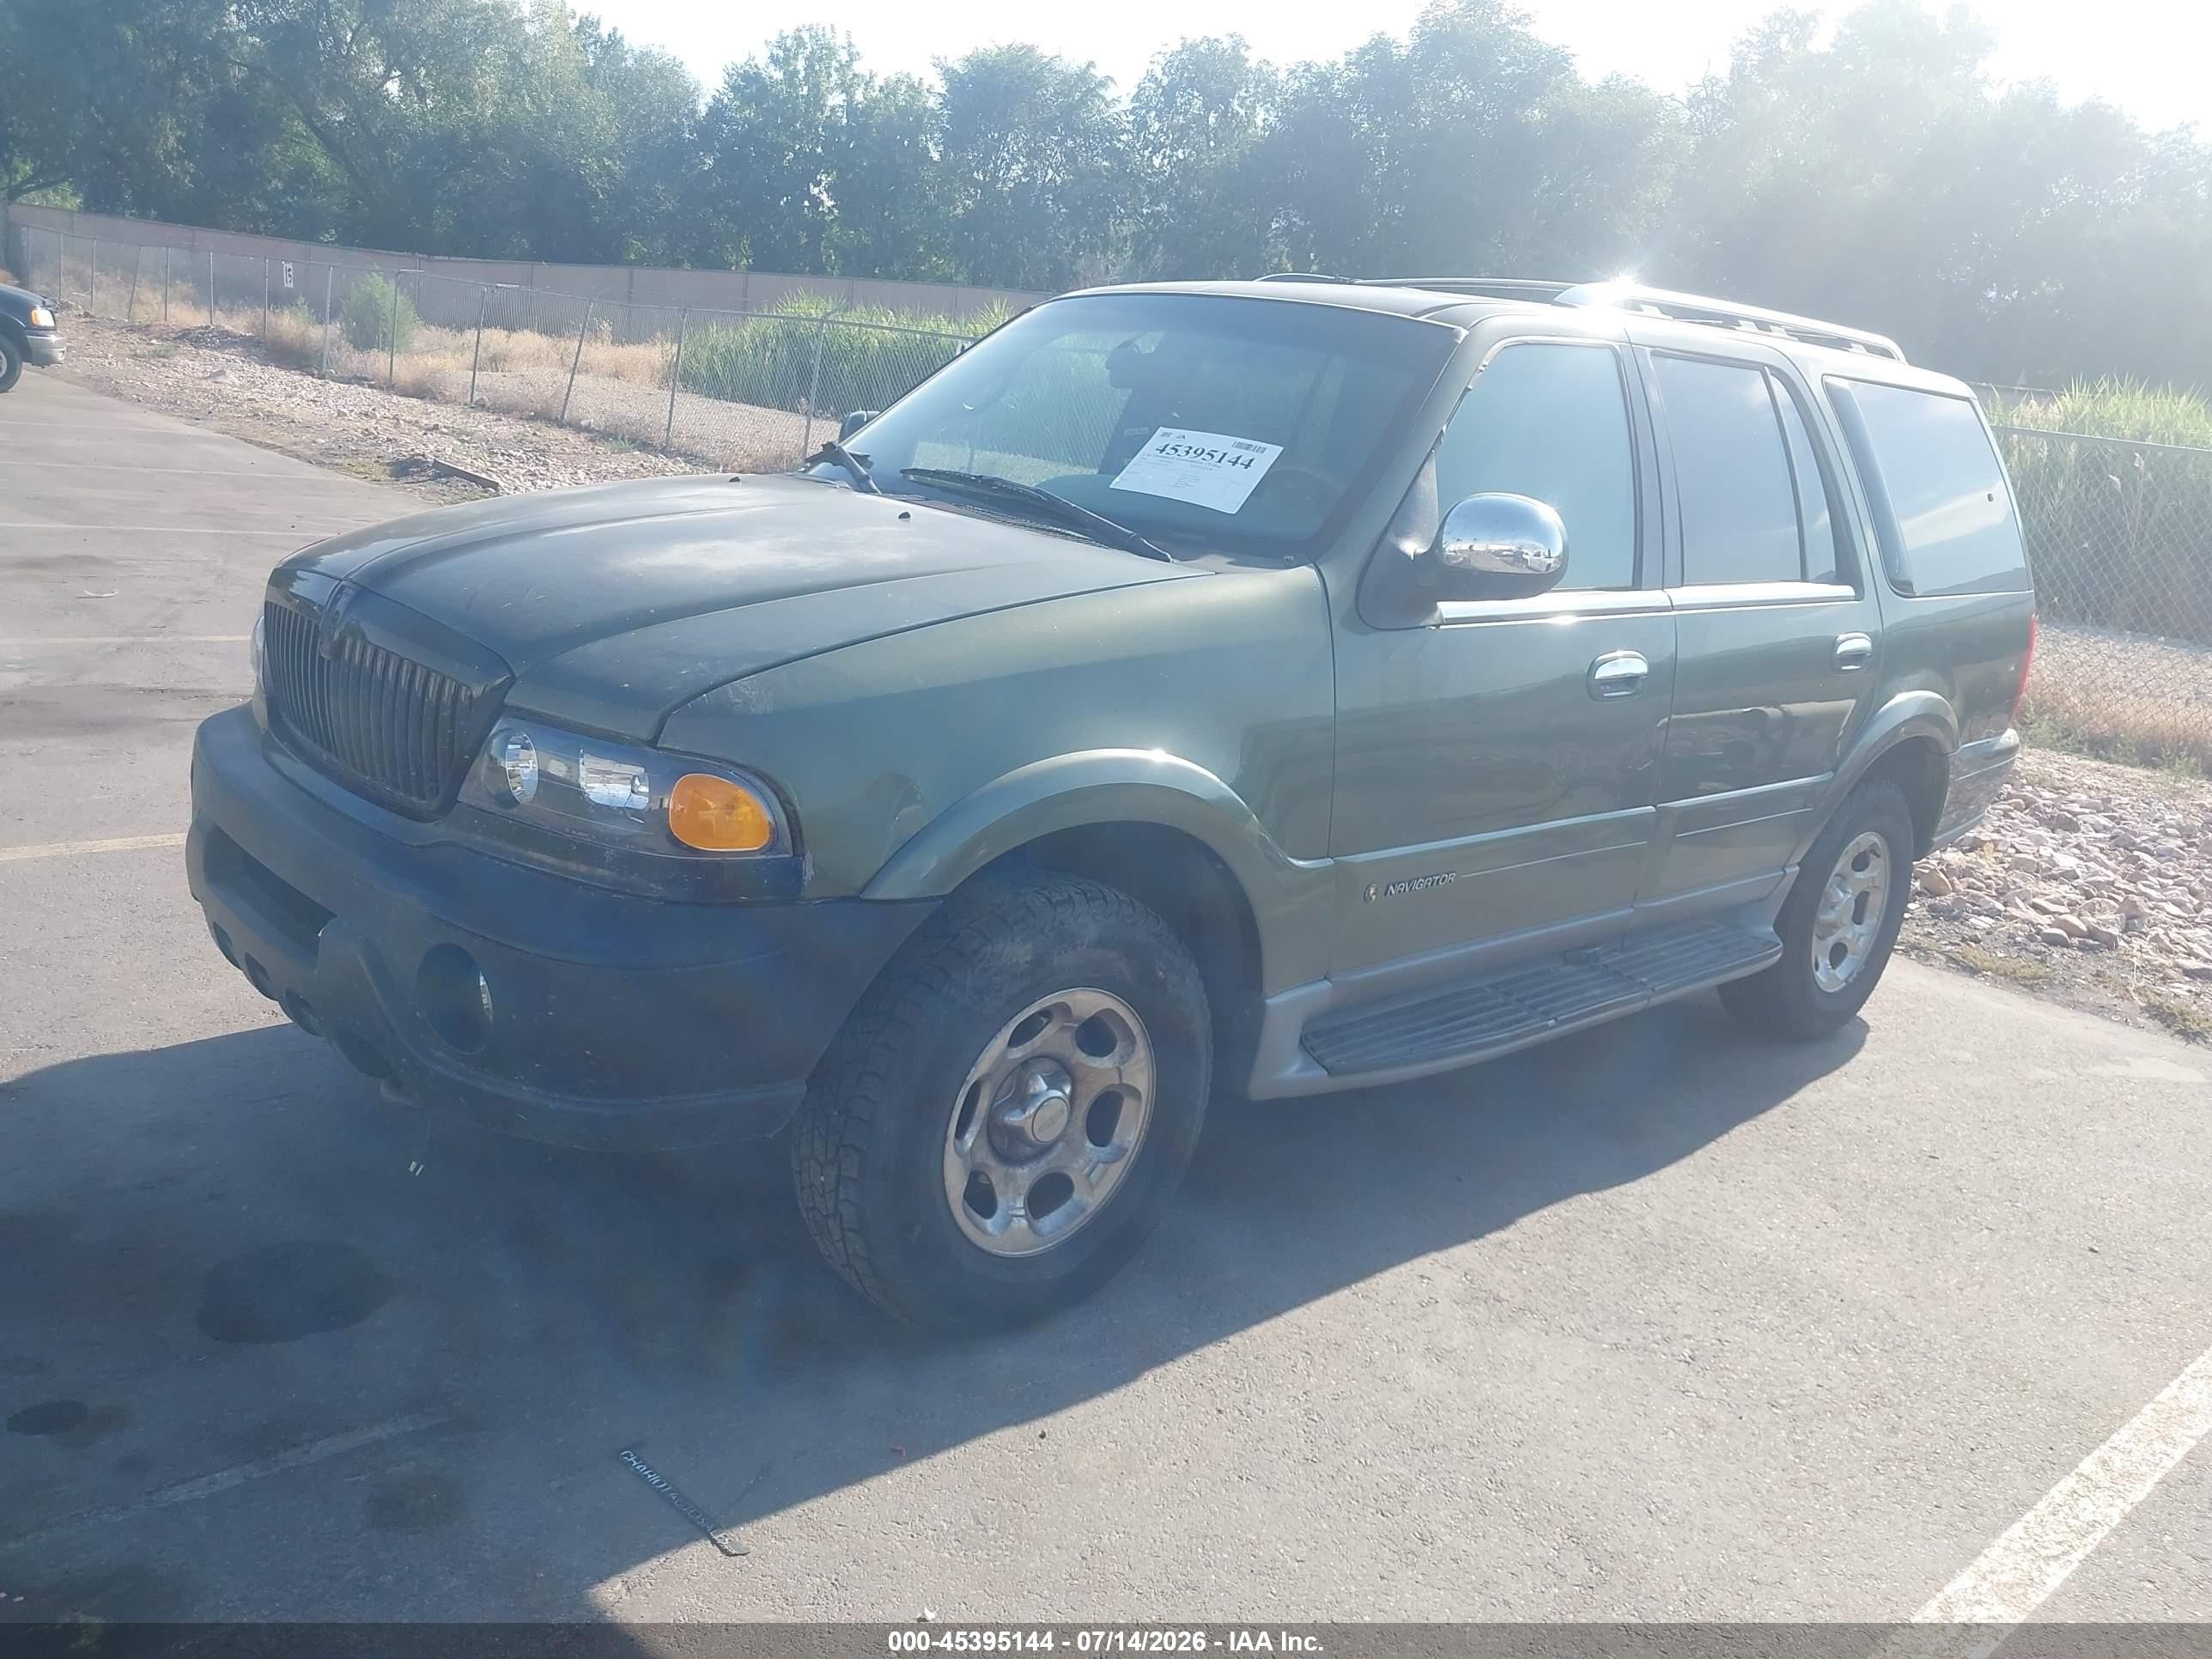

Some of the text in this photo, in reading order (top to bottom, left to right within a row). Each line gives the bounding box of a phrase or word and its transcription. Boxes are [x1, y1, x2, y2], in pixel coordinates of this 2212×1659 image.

[1155, 442, 1256, 470] 45395144
[1386, 872, 1456, 896] NAVIGATOR
[620, 1449, 672, 1492] CHARIOT
